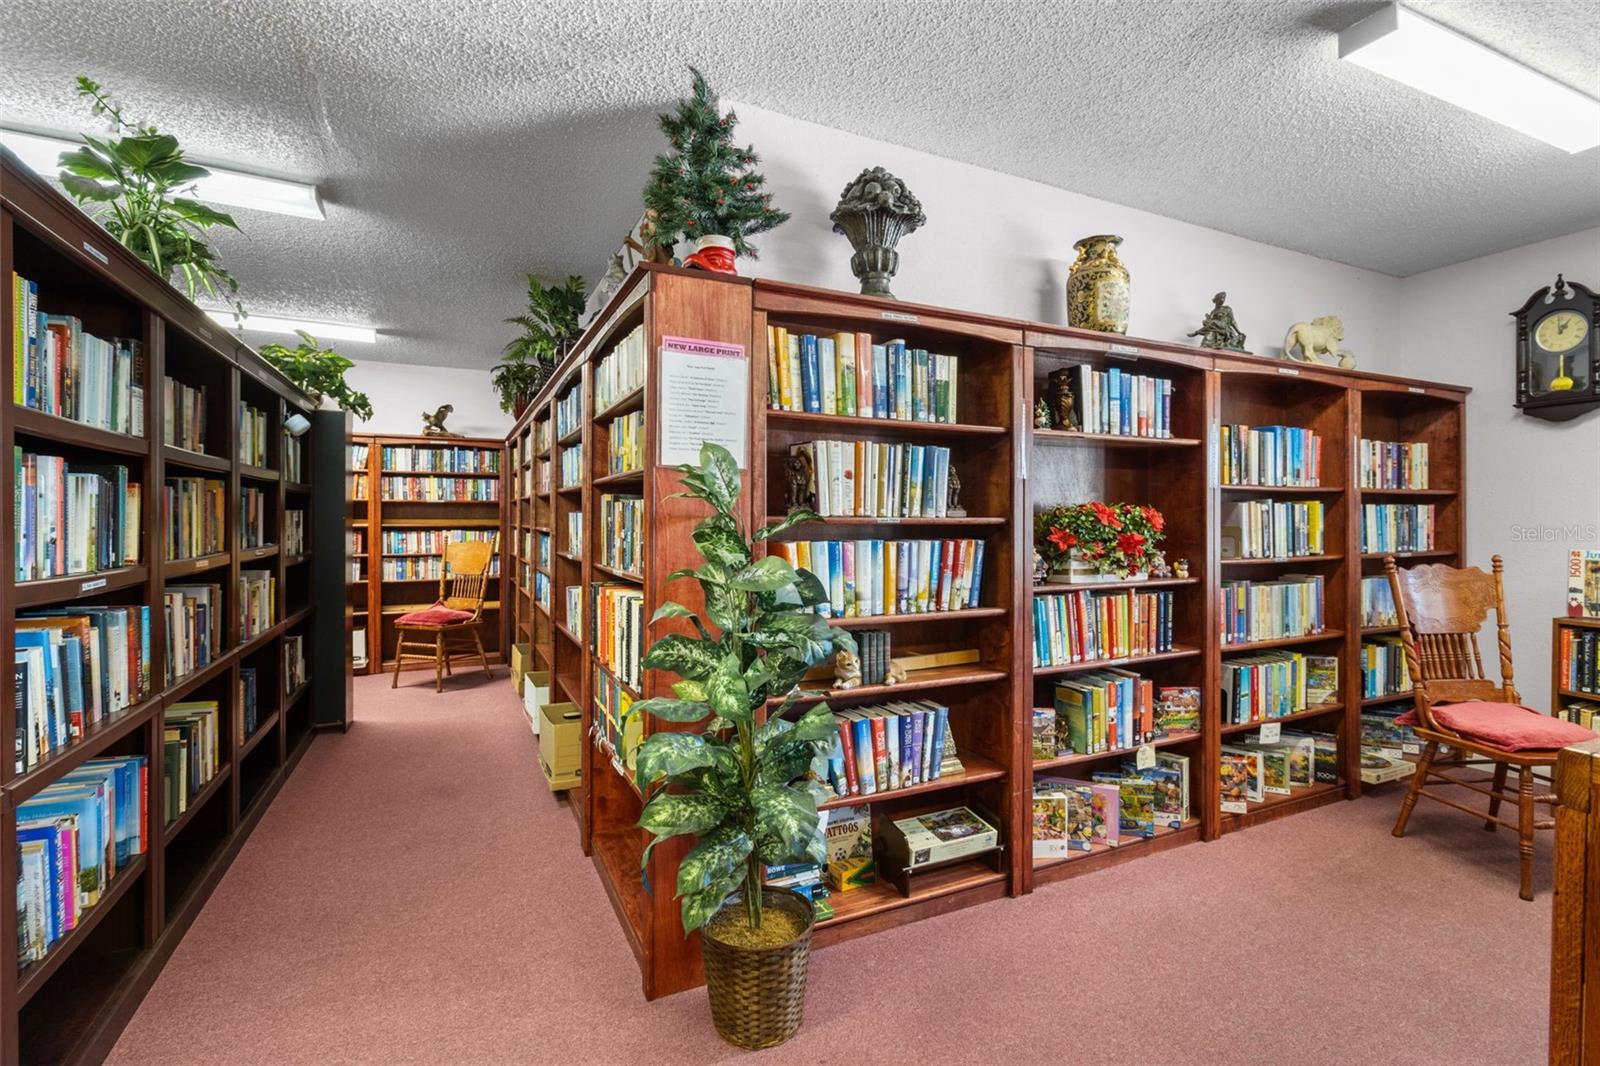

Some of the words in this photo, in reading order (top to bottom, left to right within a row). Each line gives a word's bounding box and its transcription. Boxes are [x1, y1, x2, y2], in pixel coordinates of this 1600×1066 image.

[688, 345, 715, 353] LARGE
[716, 349, 740, 357] PRINT
[1569, 558, 1581, 577] 1500
[826, 821, 859, 838] ATTOOS
